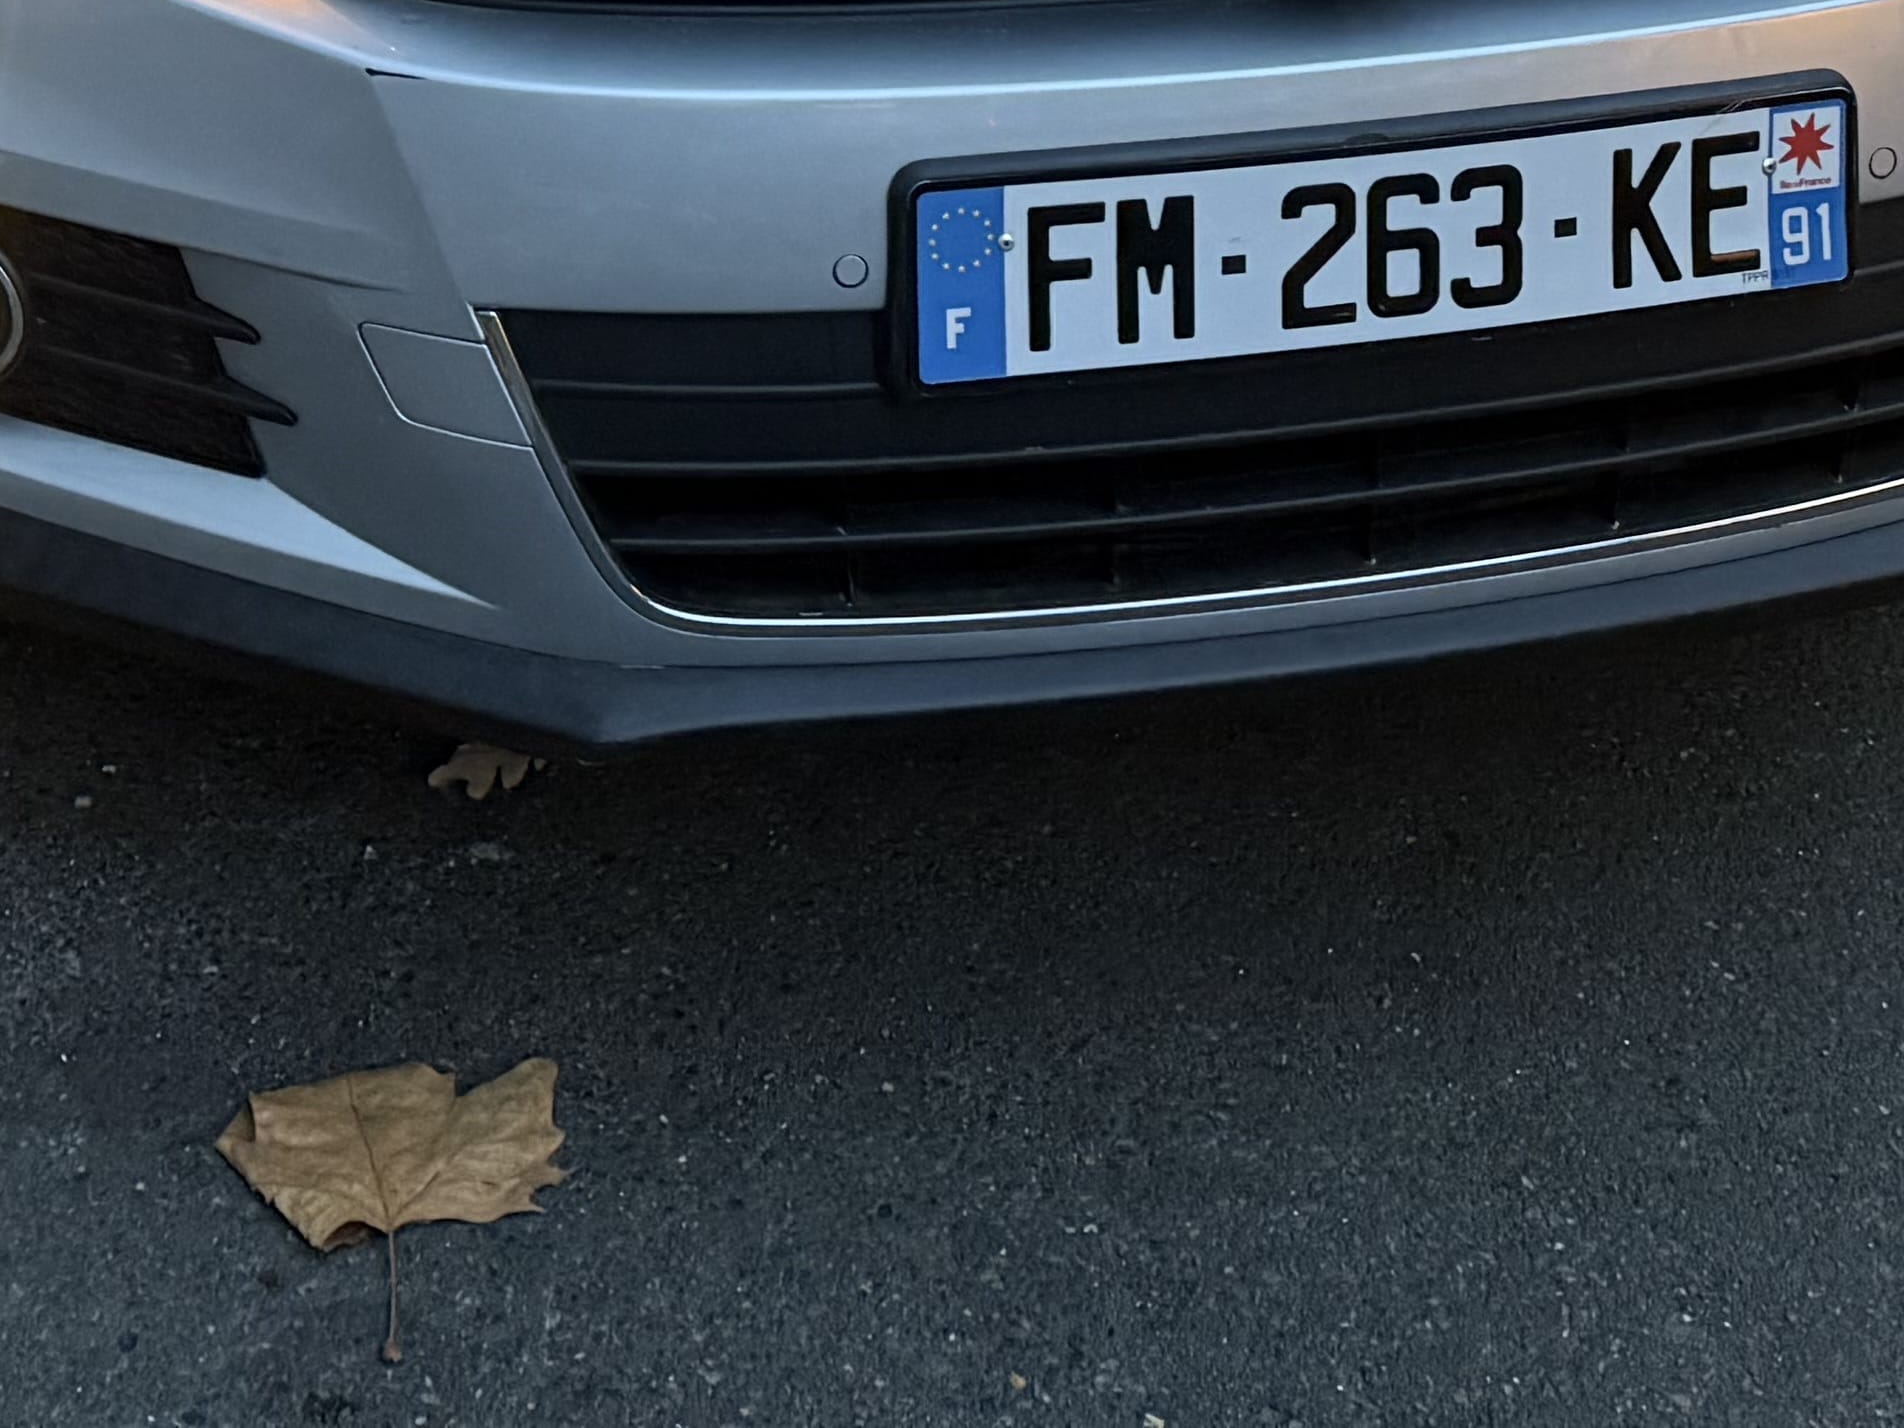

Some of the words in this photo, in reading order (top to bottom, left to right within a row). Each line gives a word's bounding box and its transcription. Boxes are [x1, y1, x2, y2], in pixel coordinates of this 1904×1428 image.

[1026, 130, 1761, 352] FM-263-KE
[1782, 202, 1831, 266] 91
[945, 307, 972, 349] F
